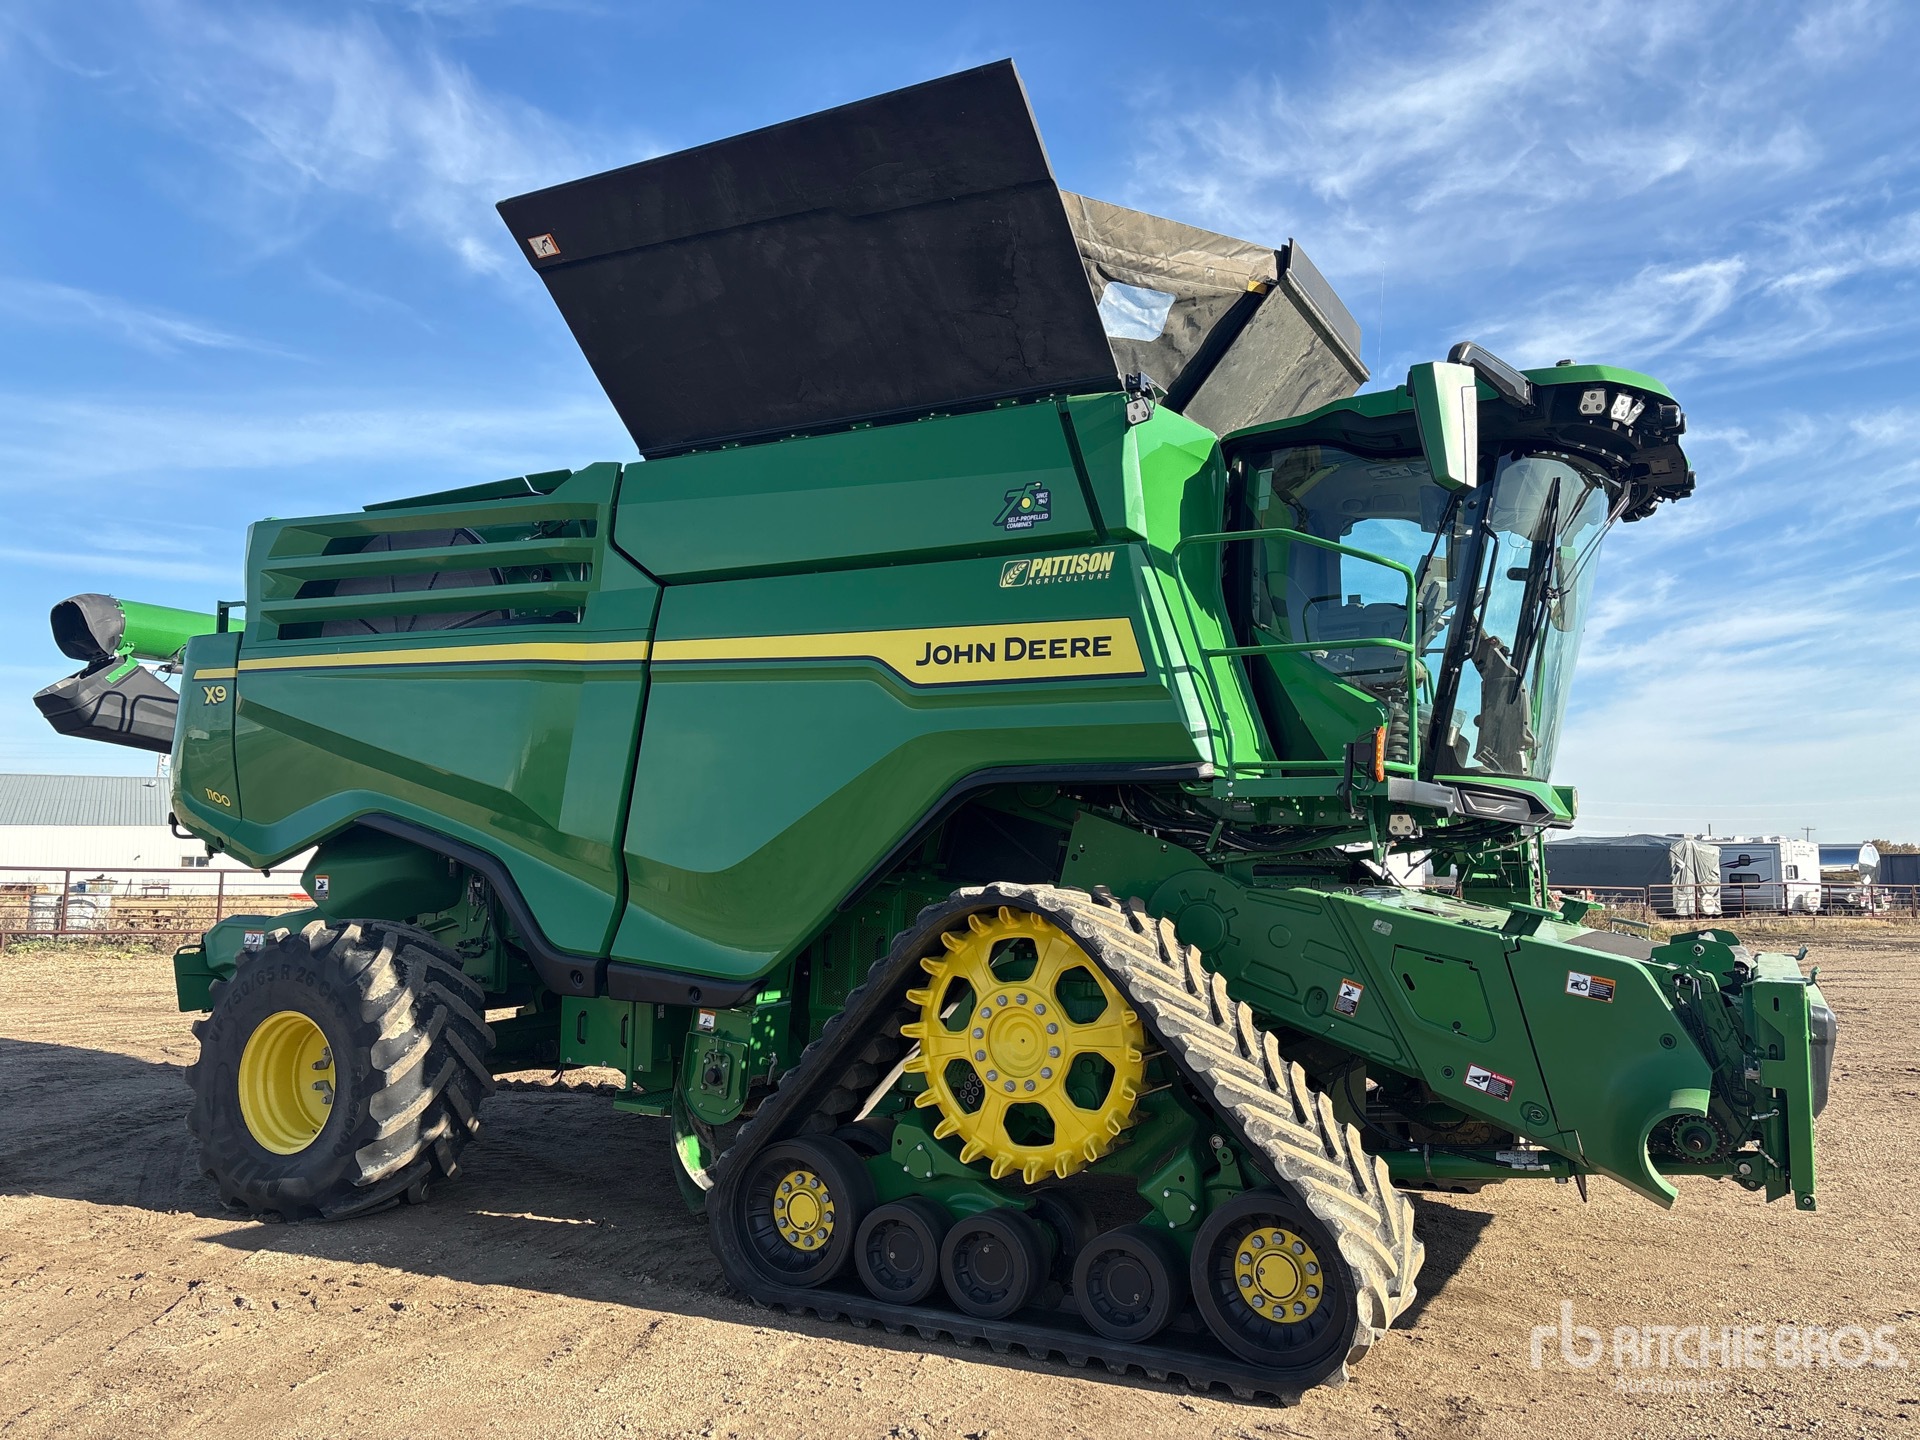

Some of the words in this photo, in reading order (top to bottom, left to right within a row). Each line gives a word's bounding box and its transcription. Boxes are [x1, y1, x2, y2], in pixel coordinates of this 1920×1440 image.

[1006, 521, 1032, 529] COMBINES
[1007, 513, 1049, 523] SELF-PROPELLED
[1029, 551, 1115, 578] PATTISON
[1027, 573, 1111, 586] AGRICULTURE
[916, 642, 996, 666] JOHN
[1004, 636, 1112, 662] DEERE
[203, 686, 227, 705] X9
[205, 788, 231, 807] 1100
[280, 963, 292, 981] R
[296, 965, 317, 987] 26
